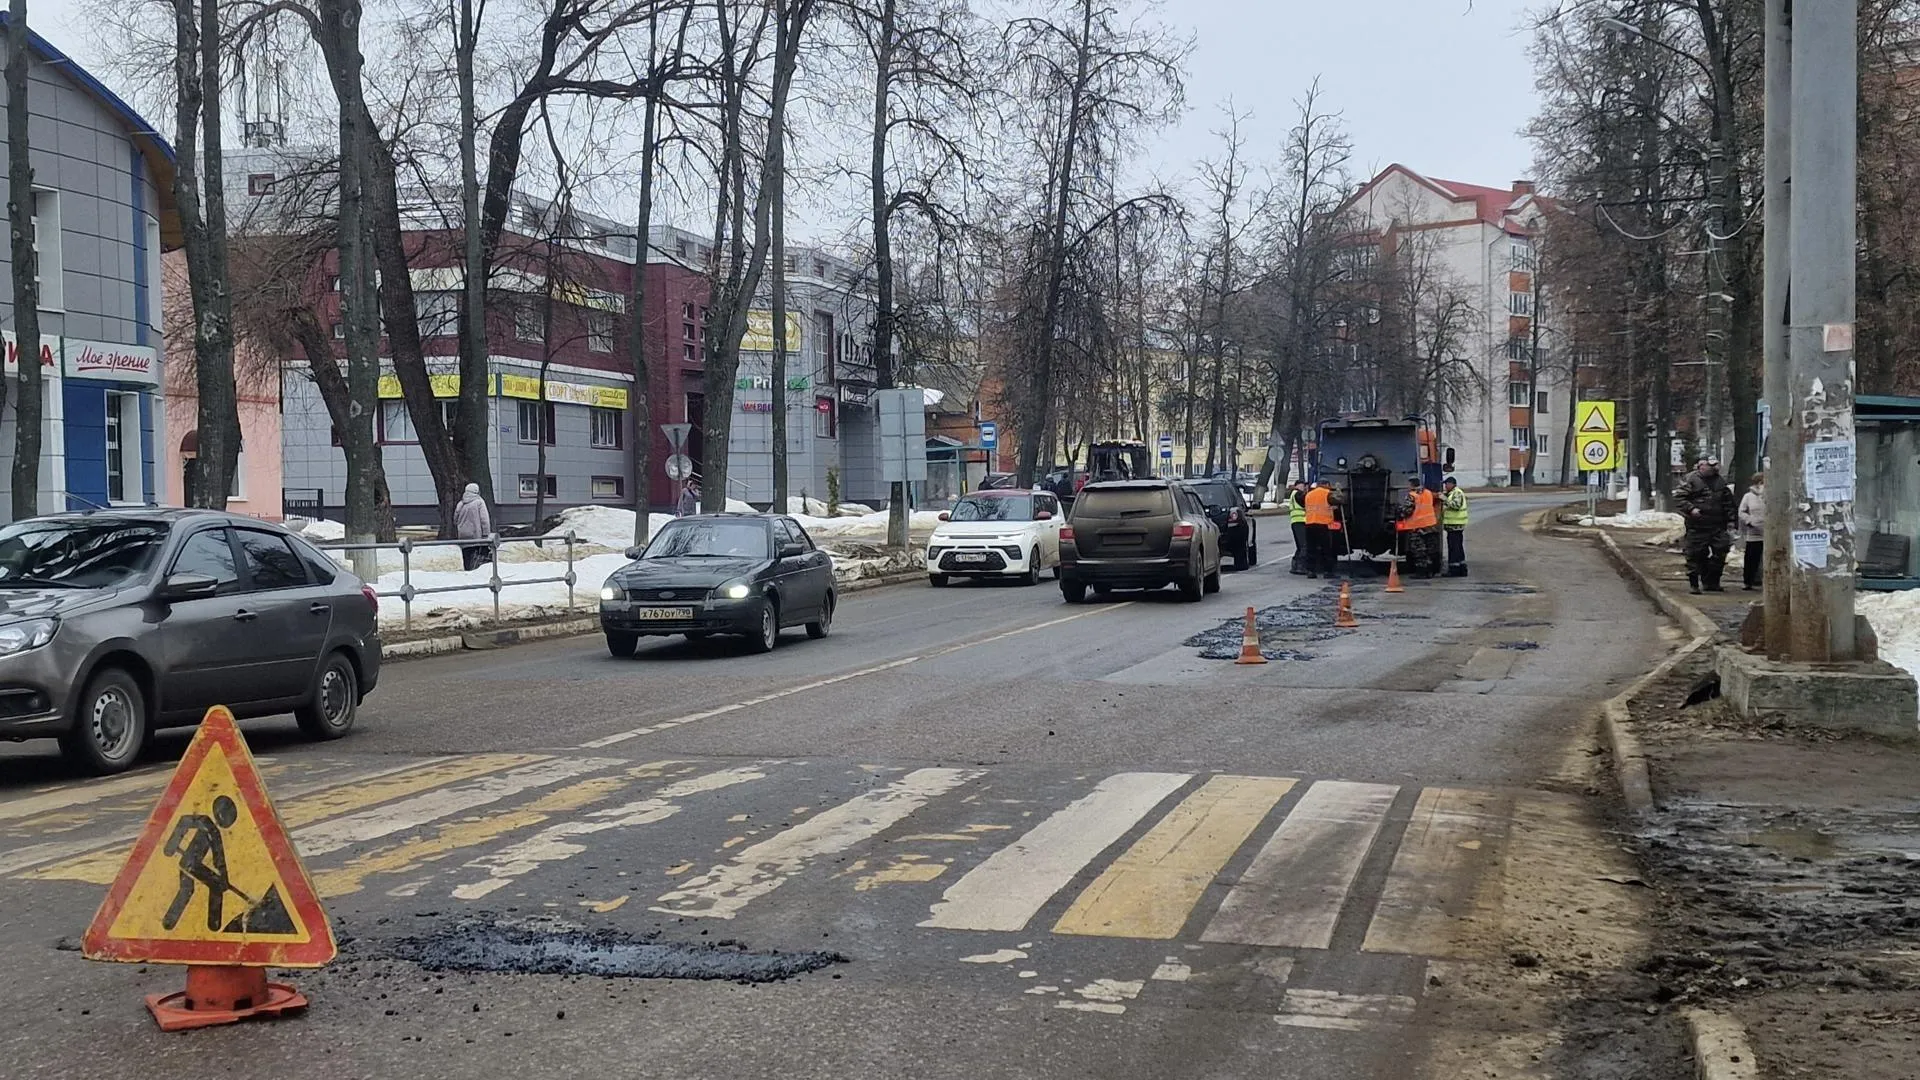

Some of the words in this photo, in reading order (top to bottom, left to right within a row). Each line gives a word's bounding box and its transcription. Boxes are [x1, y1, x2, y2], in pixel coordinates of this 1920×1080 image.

[106, 351, 151, 373] зрение
[1588, 447, 1604, 457] 40
[1794, 532, 1828, 541] КУПЛЮ
